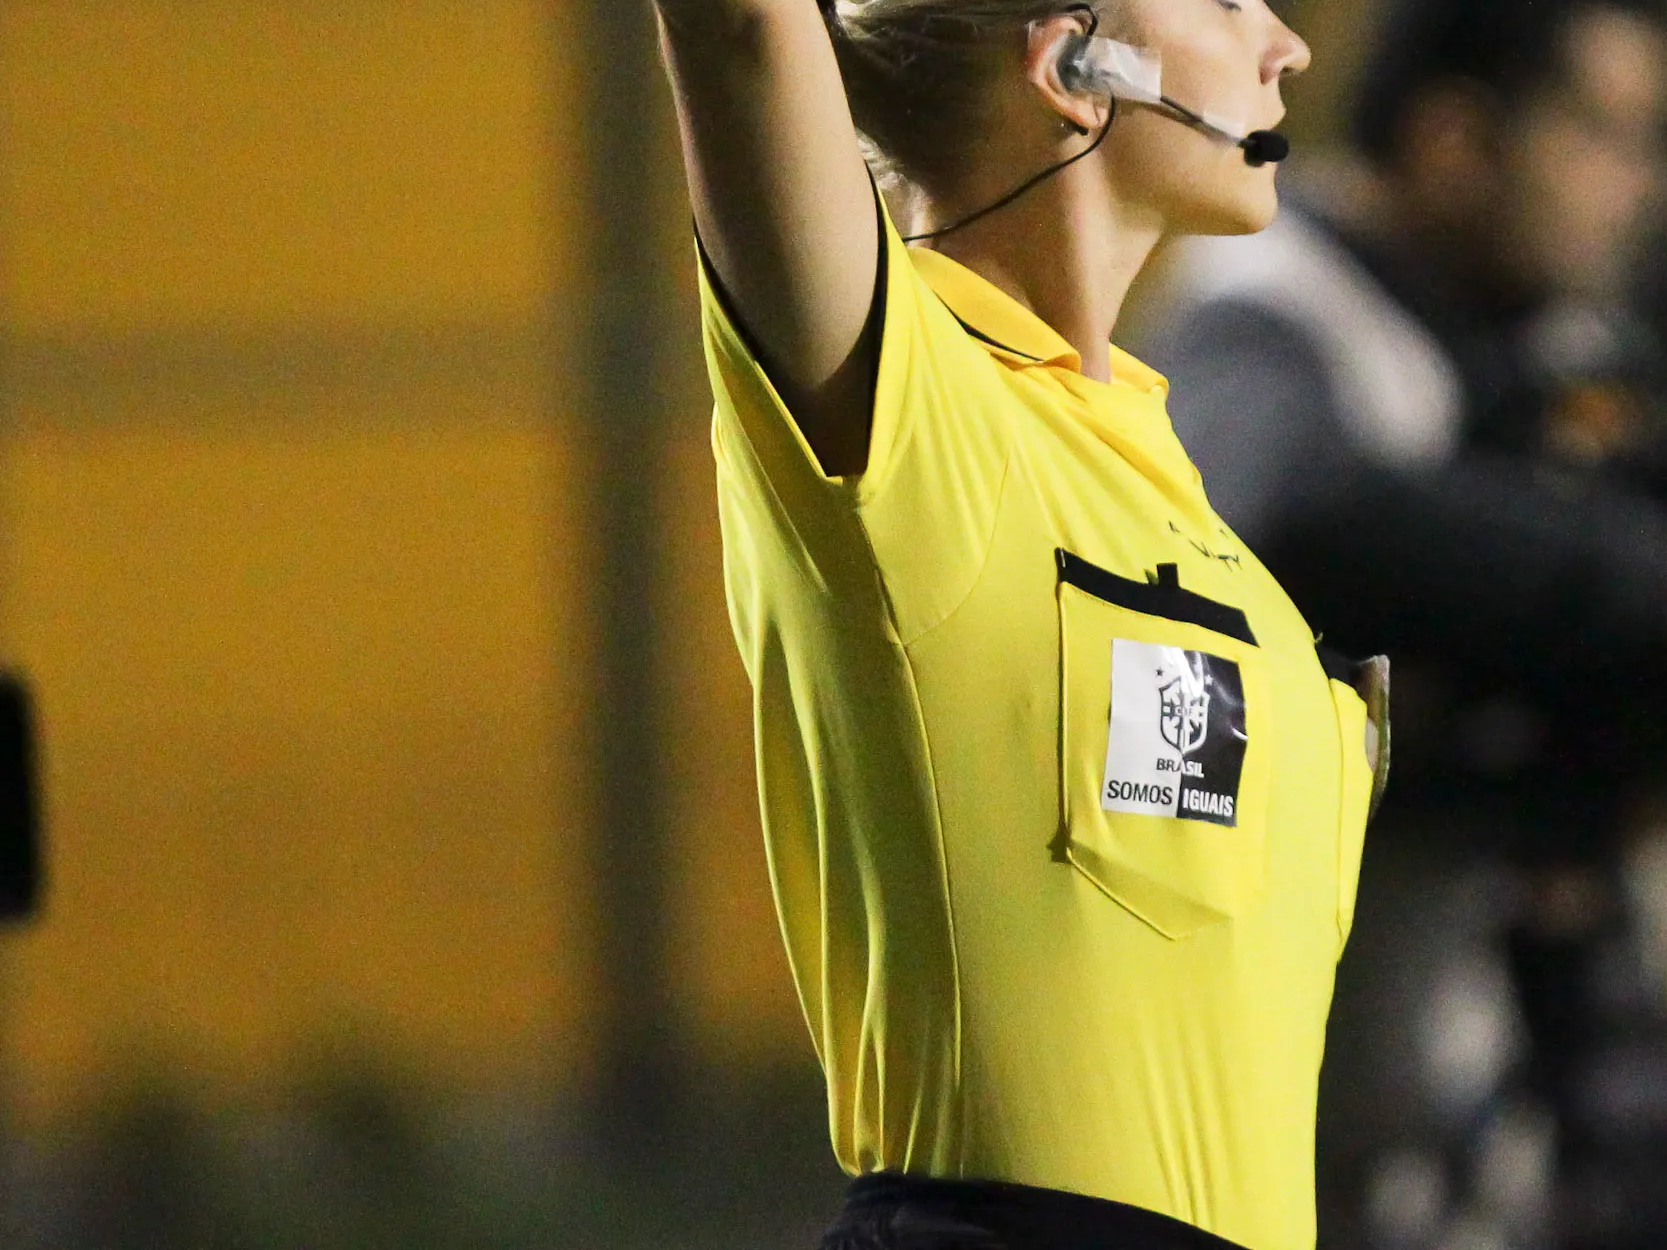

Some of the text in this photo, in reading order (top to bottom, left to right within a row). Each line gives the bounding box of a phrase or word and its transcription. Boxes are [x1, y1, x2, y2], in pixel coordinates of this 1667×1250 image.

[1156, 757, 1205, 778] BRASIL
[1107, 780, 1234, 817] SOMOS IGUAIS
